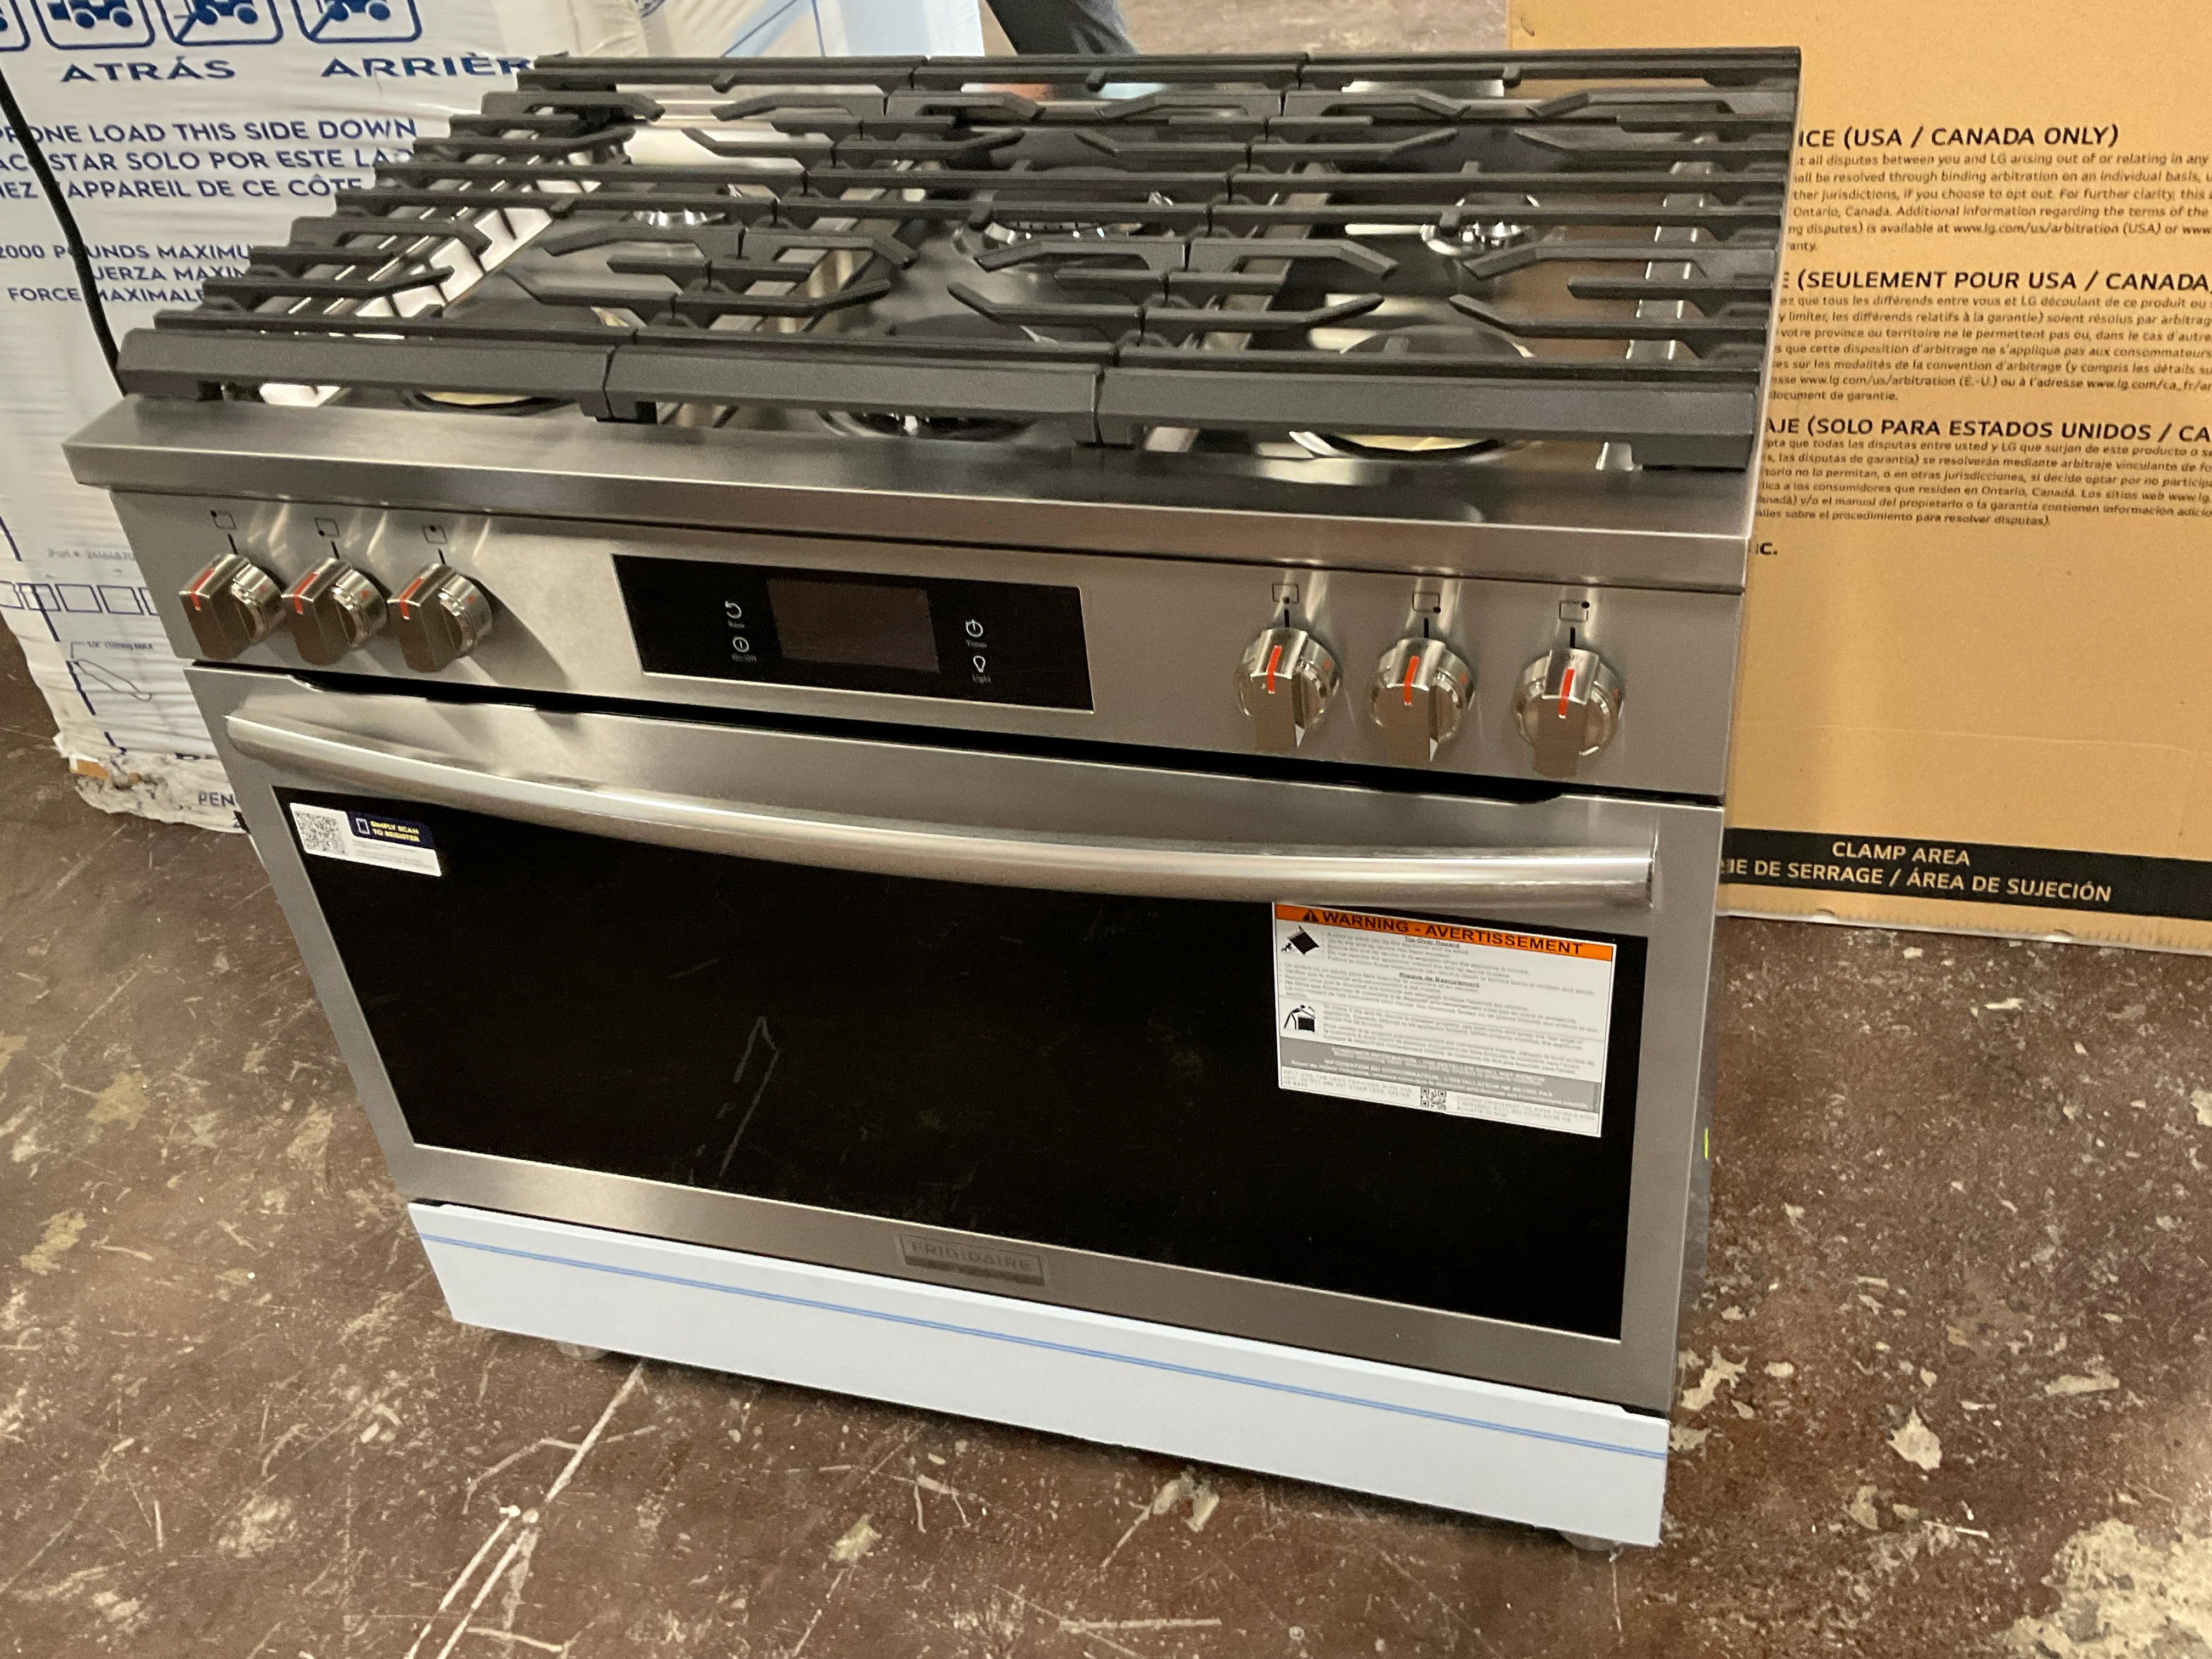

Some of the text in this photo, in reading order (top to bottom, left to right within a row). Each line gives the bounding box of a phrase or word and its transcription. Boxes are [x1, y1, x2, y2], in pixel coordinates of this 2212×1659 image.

[60, 55, 235, 82] ATRÁS
[321, 52, 531, 77] ARRIÈR
[88, 123, 165, 143] LOAD
[172, 122, 236, 141] THIS
[244, 121, 309, 140] SIDE
[319, 117, 417, 139] DOWN
[1844, 126, 1903, 150] (USA
[1910, 126, 1923, 148] /
[1932, 128, 2034, 146] CANADA
[2044, 124, 2118, 148] ONLY)
[126, 151, 200, 171] SOLO
[209, 151, 270, 169] POR
[276, 149, 341, 168] ESTE
[196, 180, 237, 198] DE
[242, 179, 281, 197] CE
[1798, 269, 1947, 291] (SEULEMENT
[1954, 272, 2019, 289] POUR
[2029, 273, 2076, 289] USA
[2084, 270, 2098, 292] /
[7, 287, 82, 301] FORCE
[1808, 415, 1872, 438] (SOLO
[1881, 419, 1941, 437] PARA
[1949, 420, 2052, 438] ESTADOS
[2061, 422, 2151, 441] UNIDOS
[2157, 422, 2171, 444] /
[199, 791, 235, 806] PEN
[1832, 841, 1970, 866] CLAMP AREA
[1754, 860, 1781, 877] DE
[1787, 862, 1883, 884] SERRAGE
[1889, 868, 1901, 887] /
[1906, 867, 1964, 890] ÁREA
[1972, 875, 2001, 894] DE
[2006, 878, 2112, 902] SUJECIÓN
[1322, 911, 1408, 932] WARNING
[1425, 925, 1583, 955] AVERTISSEMENT
[911, 1242, 1031, 1270] FRIGIDAIRE
